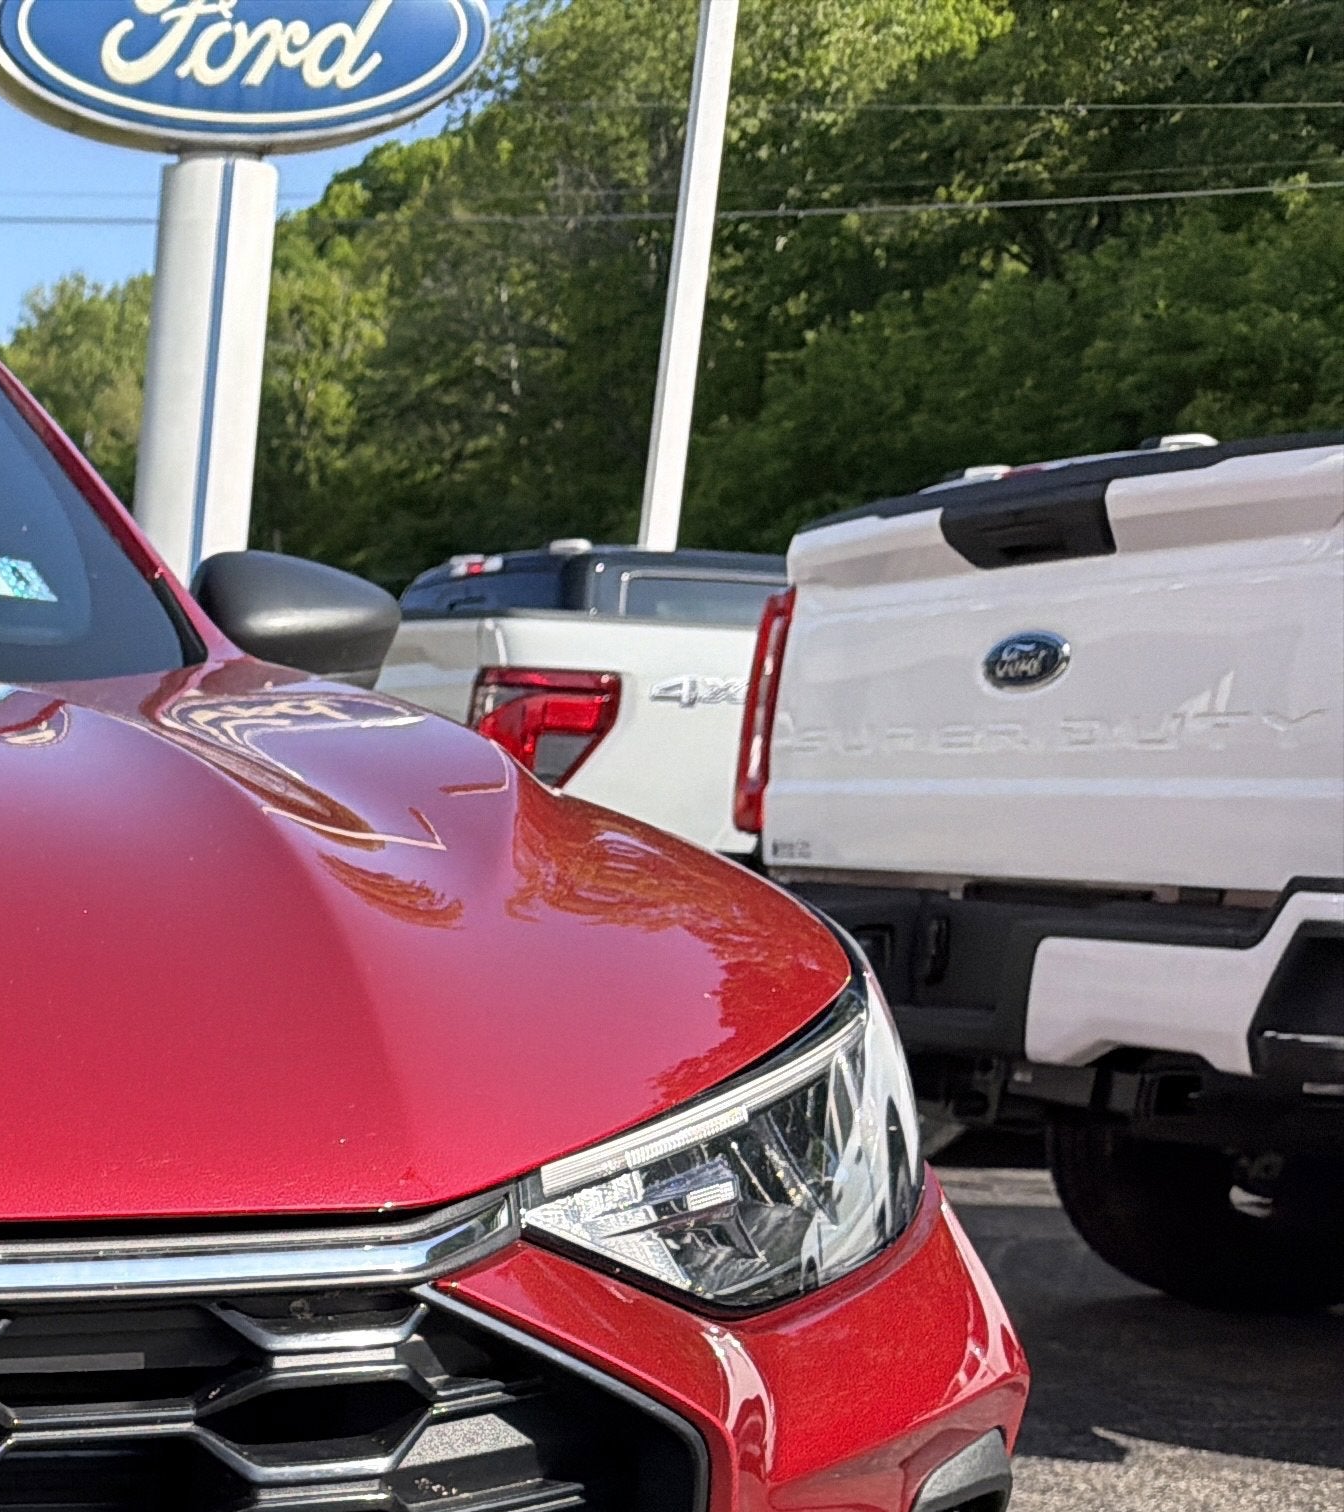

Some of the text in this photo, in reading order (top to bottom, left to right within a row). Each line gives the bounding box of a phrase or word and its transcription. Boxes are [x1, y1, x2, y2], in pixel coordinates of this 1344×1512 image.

[100, 0, 383, 90] Ford
[995, 643, 1048, 678] Ford
[649, 674, 751, 708] 4X
[790, 707, 1328, 753] SUPER DUTY
